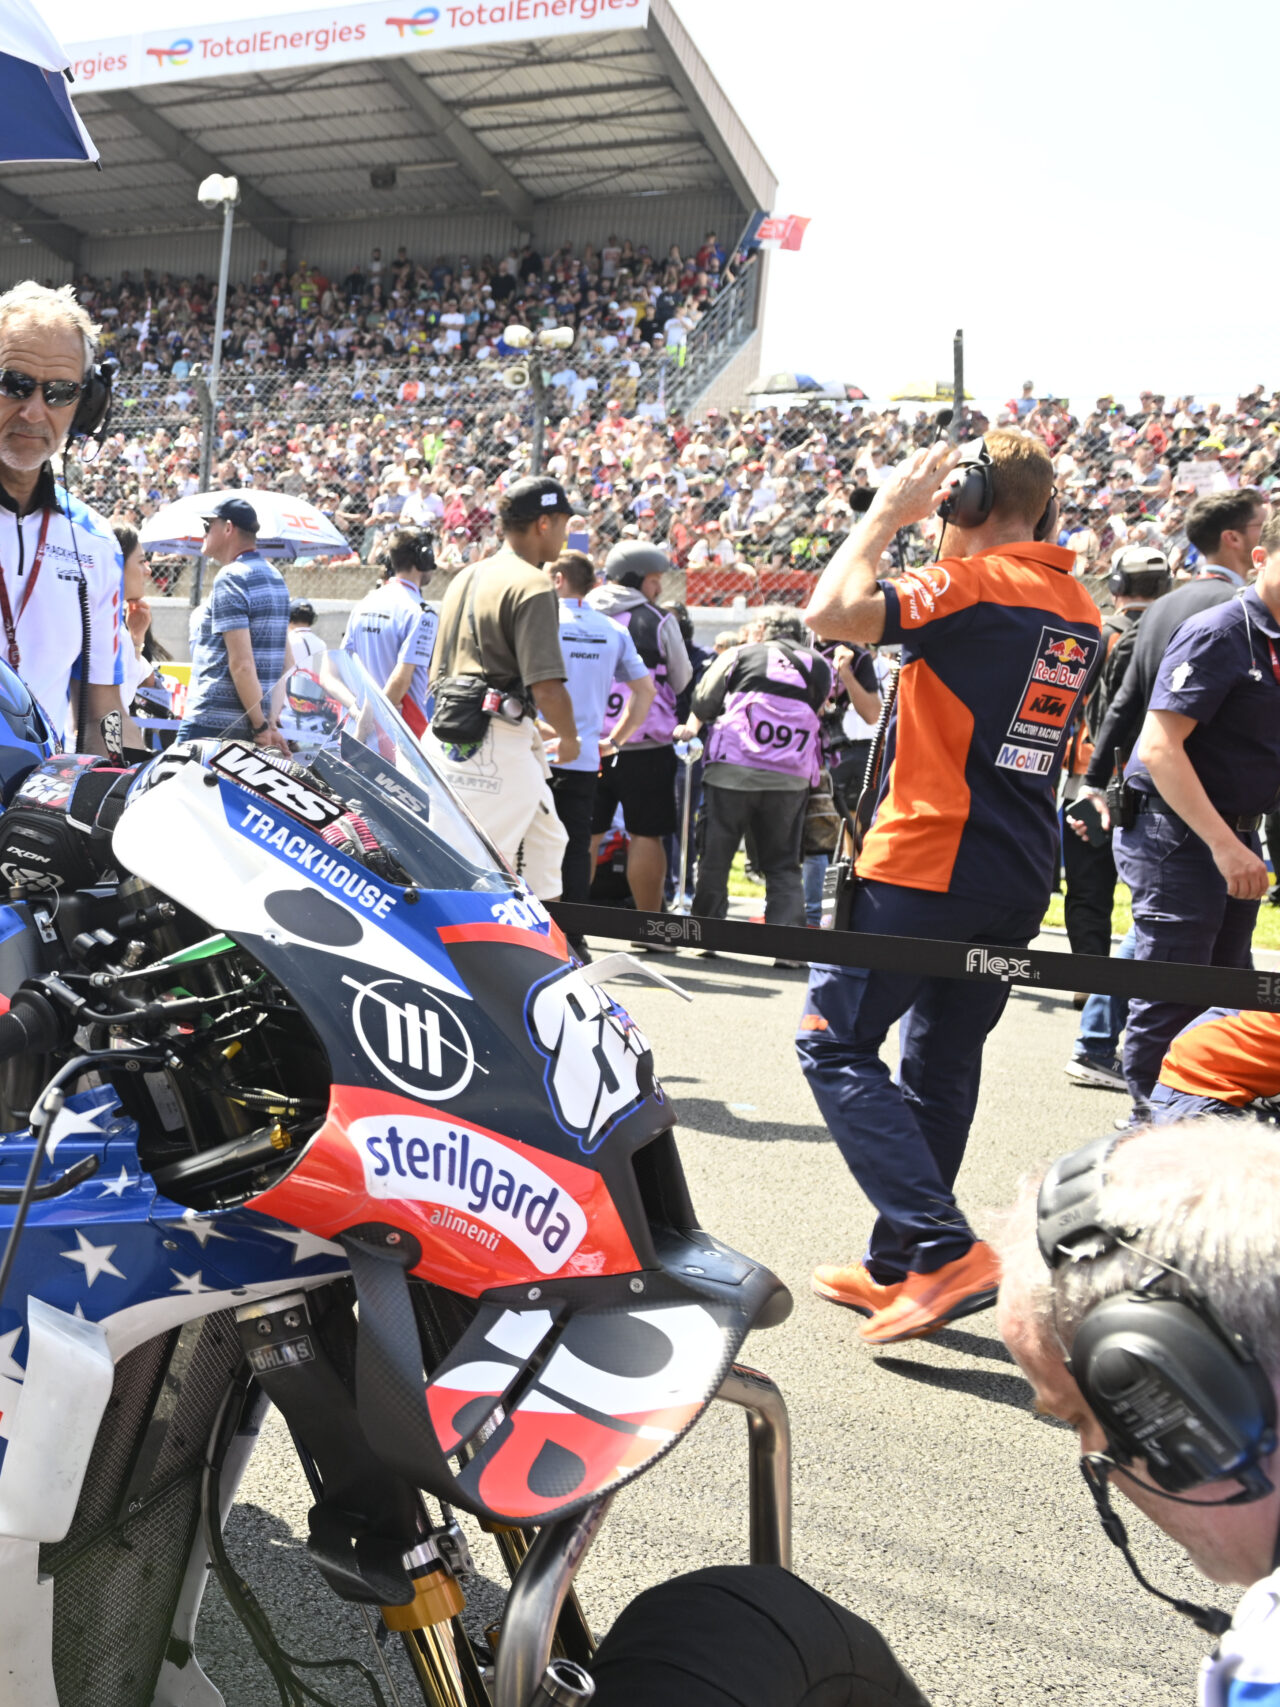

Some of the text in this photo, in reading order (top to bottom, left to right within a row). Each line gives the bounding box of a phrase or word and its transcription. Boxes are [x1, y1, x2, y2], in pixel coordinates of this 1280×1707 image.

[198, 21, 367, 60] TotalEnergies
[570, 651, 600, 660] DUCATI
[1032, 658, 1087, 690] Red Bull
[1029, 693, 1067, 717] KTM
[754, 720, 811, 752] 097
[1012, 721, 1061, 741] FACTORY RACING
[998, 746, 1038, 771] Mobil
[215, 745, 340, 822] WRS
[6, 846, 51, 863] IXON
[239, 804, 398, 920] TRACKHOUSE
[366, 1126, 571, 1254] sterilgarda
[429, 1207, 502, 1252] alimenti
